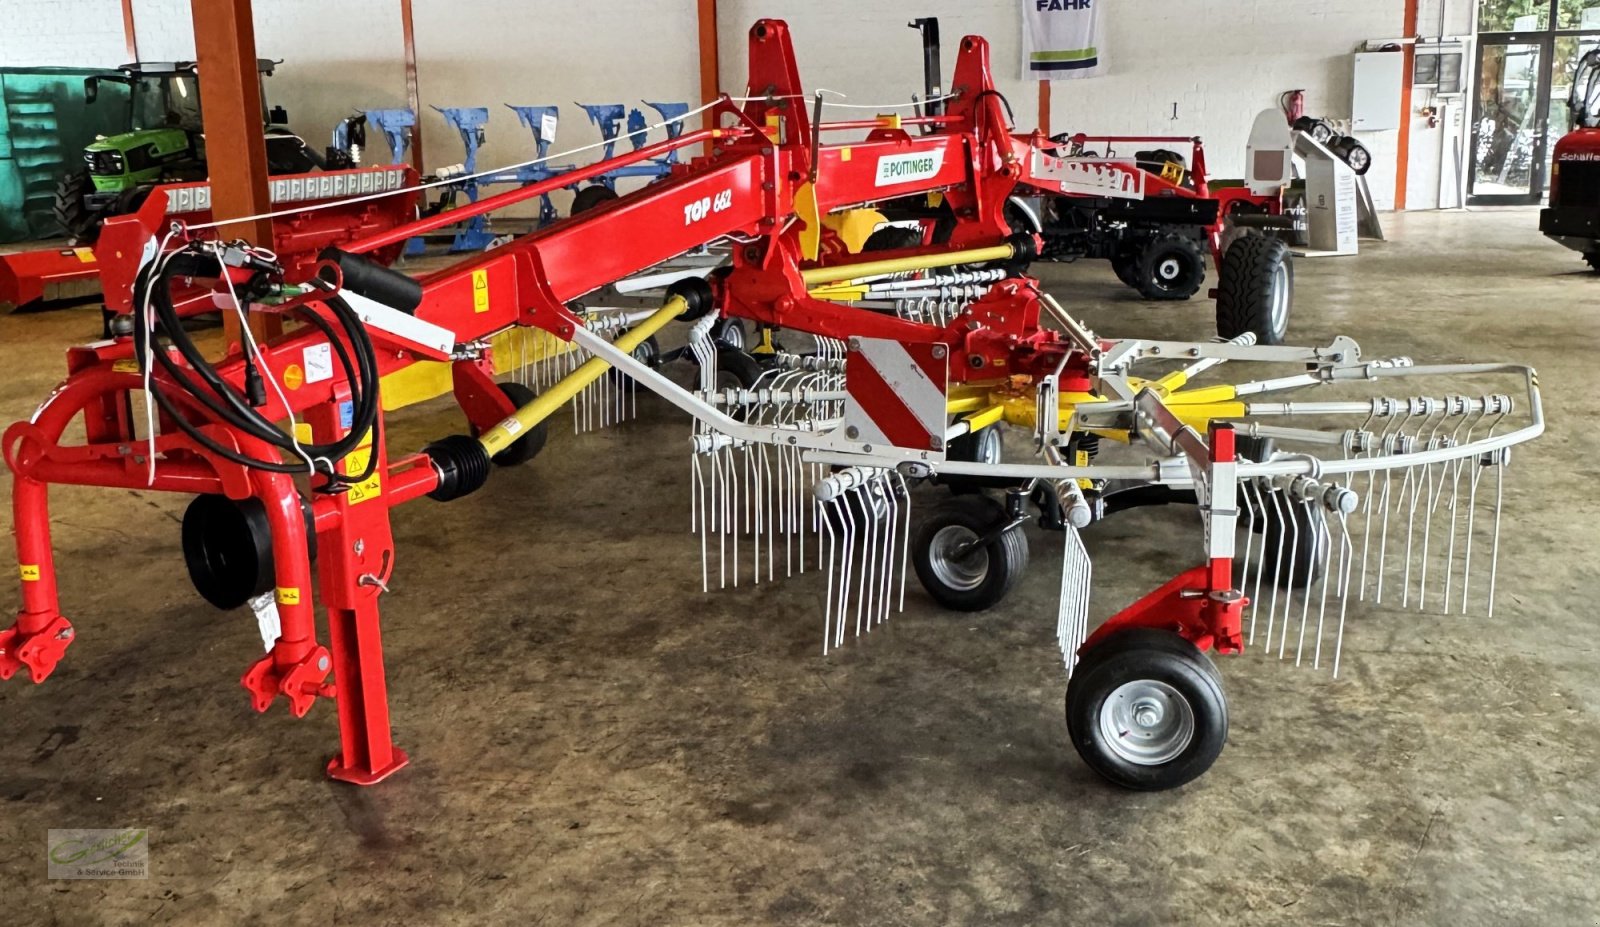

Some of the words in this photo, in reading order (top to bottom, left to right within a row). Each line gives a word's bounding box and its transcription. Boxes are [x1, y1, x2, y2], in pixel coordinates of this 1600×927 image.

[1036, 0, 1091, 12] FAHR
[684, 196, 711, 226] TOP
[713, 188, 732, 213] 662
